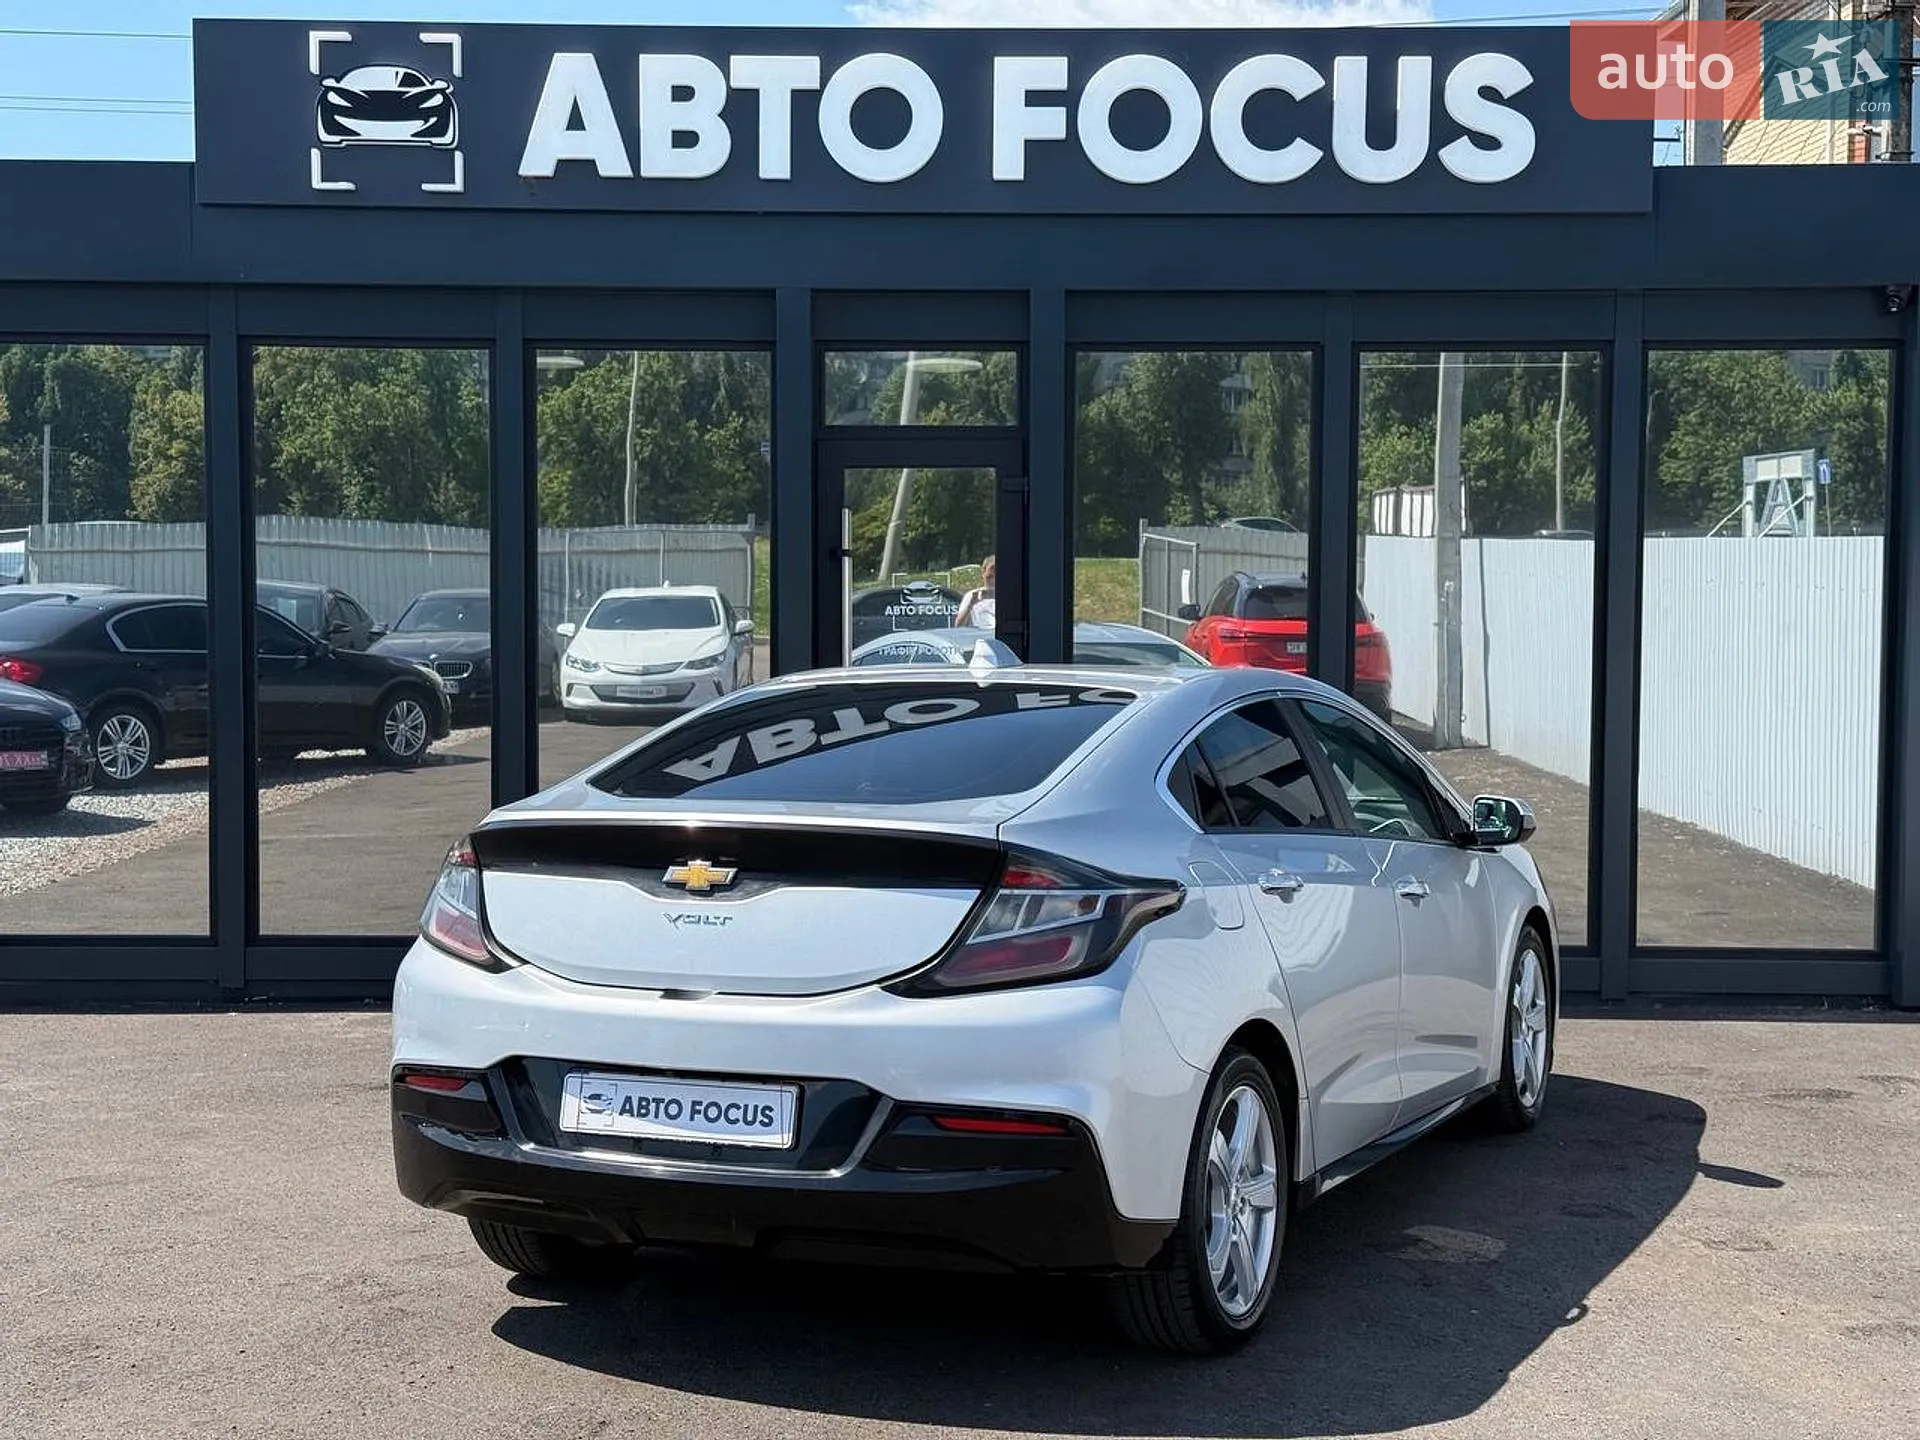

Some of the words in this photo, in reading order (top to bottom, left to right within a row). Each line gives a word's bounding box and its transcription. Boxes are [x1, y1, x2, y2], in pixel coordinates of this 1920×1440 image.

[519, 53, 943, 184] АВТО
[992, 52, 1536, 184] FOCUS
[885, 605, 916, 616] АВТО
[919, 604, 960, 615] FOCUS
[663, 913, 733, 930] VOLT
[619, 1096, 683, 1120] АВТО
[690, 1100, 774, 1127] FOCUS
